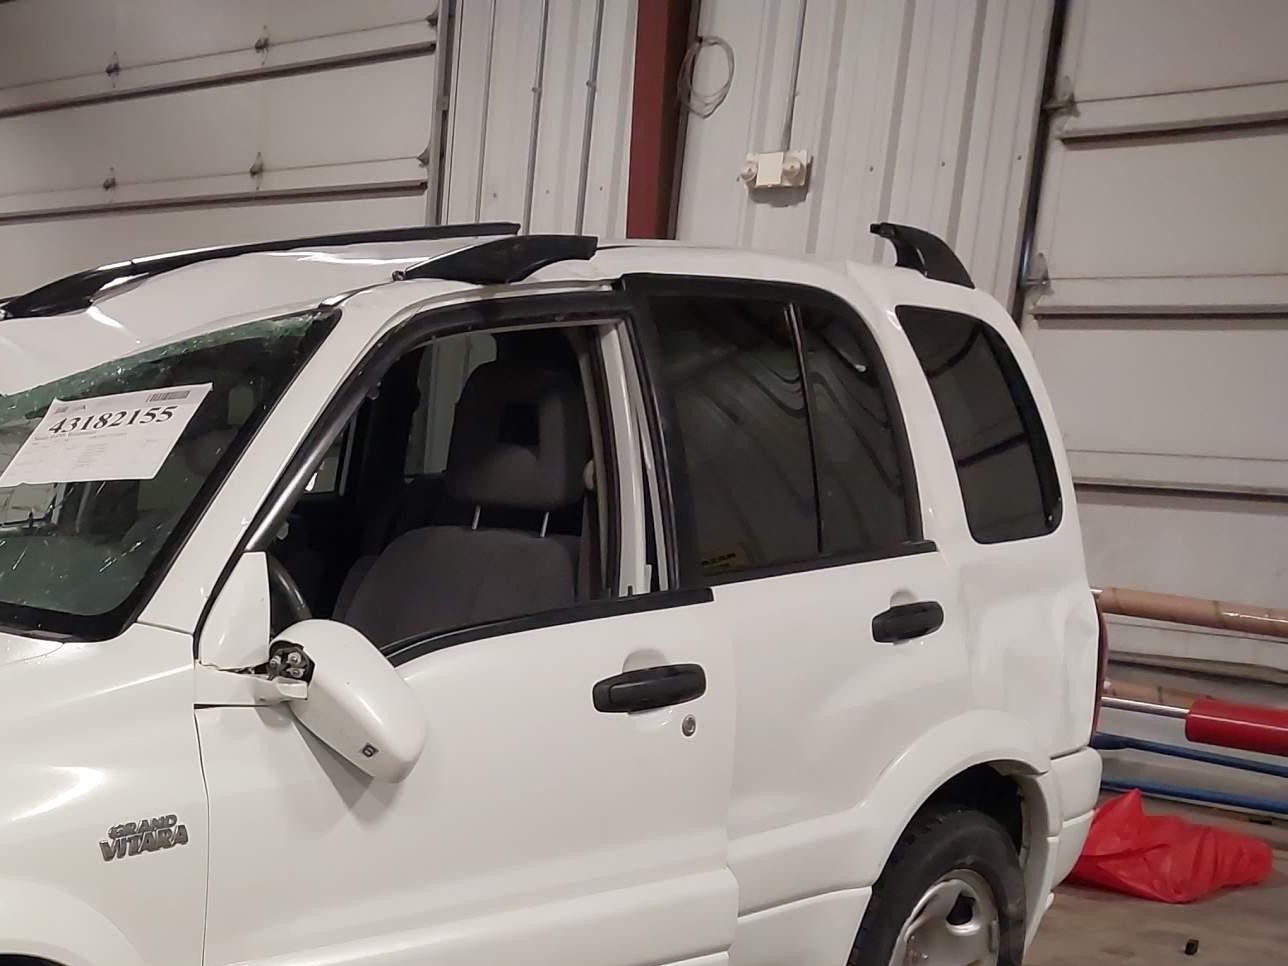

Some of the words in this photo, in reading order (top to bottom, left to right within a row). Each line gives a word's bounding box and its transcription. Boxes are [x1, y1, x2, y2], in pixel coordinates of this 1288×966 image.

[49, 405, 179, 434] 43182155
[108, 814, 178, 839] GRAND
[99, 825, 188, 861] VITARA
